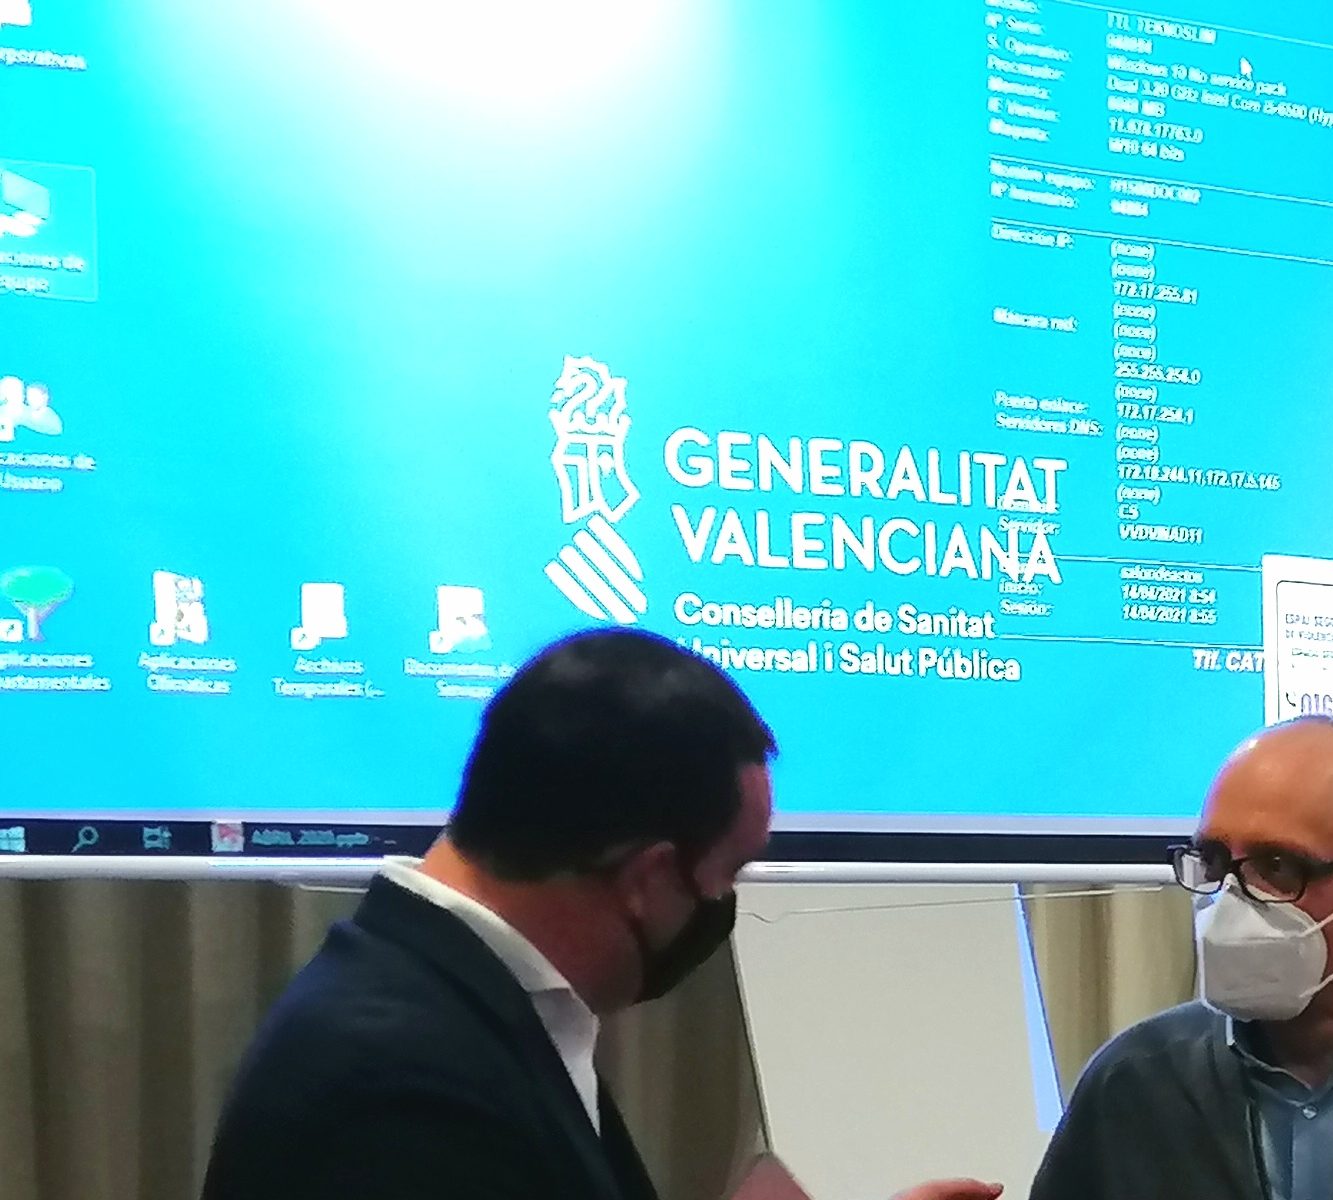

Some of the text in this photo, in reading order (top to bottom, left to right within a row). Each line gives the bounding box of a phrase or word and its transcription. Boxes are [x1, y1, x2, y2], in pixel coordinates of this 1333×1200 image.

[1106, 74, 1139, 93] Dual
[1231, 93, 1261, 112] Core
[1107, 54, 1168, 77] Windows
[1210, 73, 1255, 91] service
[1255, 81, 1287, 97] pack
[664, 425, 1068, 513] GENERALITAT
[671, 503, 1064, 585] VALENCIANA
[674, 591, 996, 639] Conselleria de Sanitat
[678, 637, 1022, 681] niversal i Salut Pública
